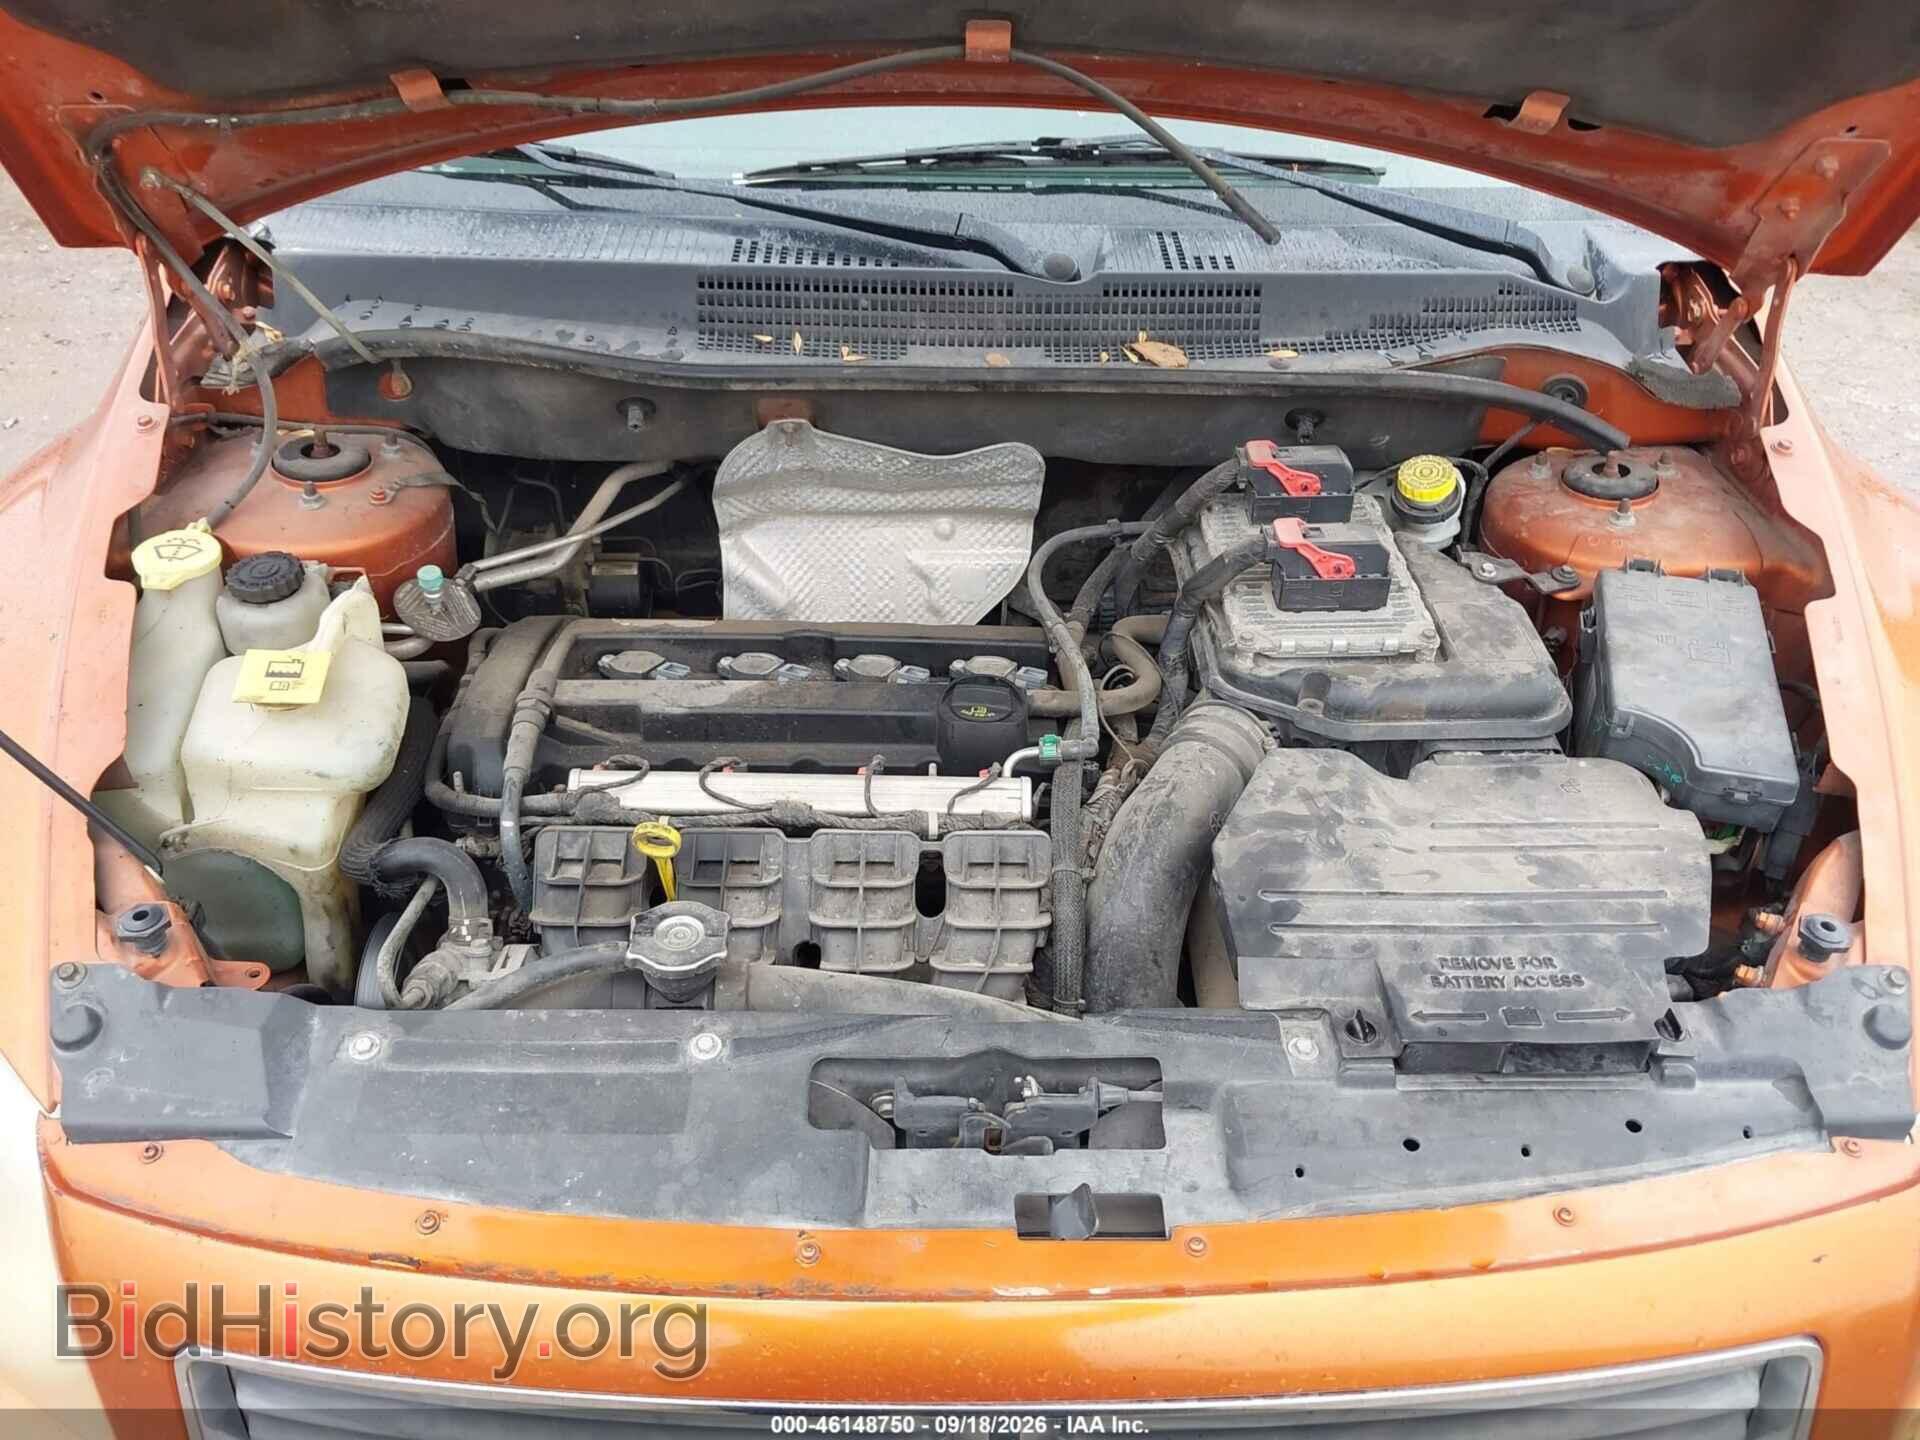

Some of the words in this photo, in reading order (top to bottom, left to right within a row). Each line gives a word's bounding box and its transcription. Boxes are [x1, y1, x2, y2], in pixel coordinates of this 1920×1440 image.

[1438, 956, 1515, 970] REMOVE
[1520, 956, 1557, 970] FOR
[1430, 975, 1507, 989] BATTERY
[1513, 974, 1585, 988] ACCESS
